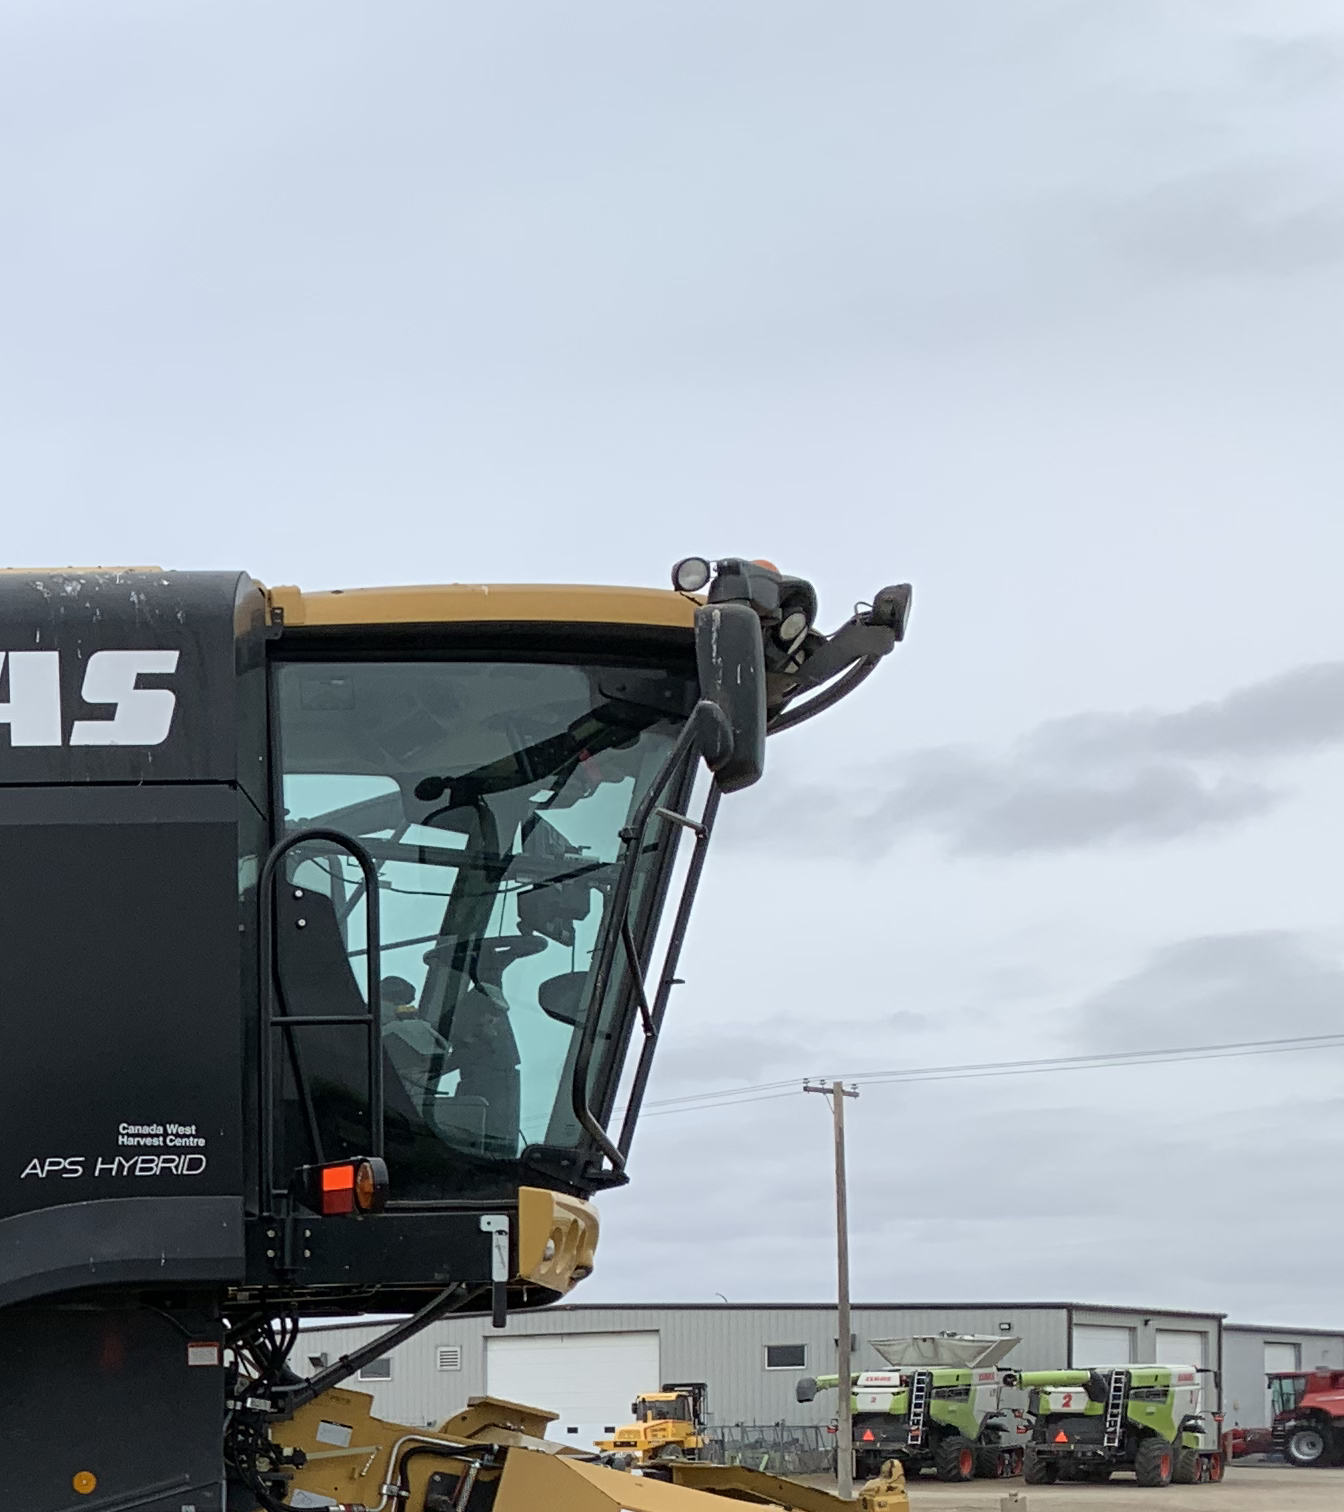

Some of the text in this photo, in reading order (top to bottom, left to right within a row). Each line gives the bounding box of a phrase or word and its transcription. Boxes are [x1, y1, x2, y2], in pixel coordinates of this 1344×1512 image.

[118, 1122, 197, 1135] Canada West
[118, 1135, 206, 1147] Harvest Centre
[20, 1154, 207, 1179] APS HYBRID
[1061, 1394, 1073, 1409] 2
